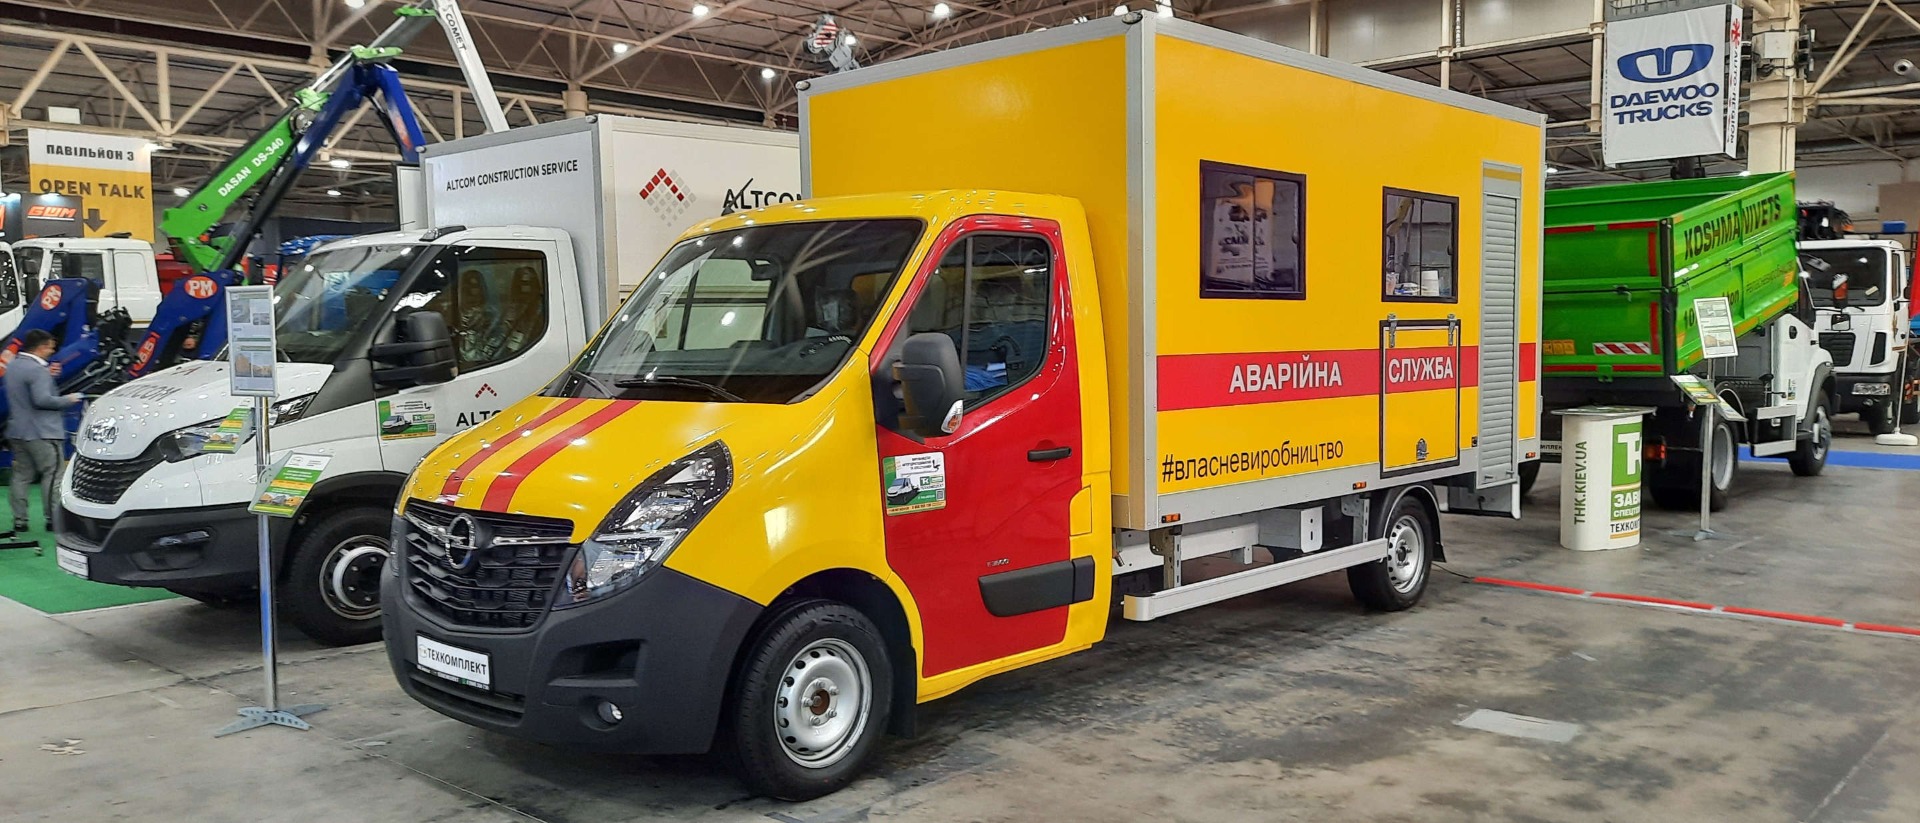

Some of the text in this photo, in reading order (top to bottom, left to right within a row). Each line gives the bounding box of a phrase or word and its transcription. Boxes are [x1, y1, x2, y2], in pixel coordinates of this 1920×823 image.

[446, 13, 467, 51] COMET
[1610, 83, 1719, 108] DAEWOO
[1613, 101, 1713, 124] TRUCKS
[46, 144, 134, 161] ПАВІЛЬЙОН 3
[218, 138, 284, 197] DASAN DS-340
[446, 159, 578, 191] ALTCOM CONSTRUCTION SERVICE
[39, 178, 145, 199] OPEN TALK
[722, 188, 801, 209] ALTCO
[43, 285, 62, 309] PM
[188, 280, 215, 297] PM
[1228, 354, 1454, 393] АВАРІЙНА СЛУЖБА
[1161, 438, 1344, 483] #власневиробництво
[1574, 441, 1587, 525] THK.KIEV.UA
[1613, 492, 1640, 508] ЗАВ
[427, 648, 487, 675] ТЕХКОМПЛЕКТ
